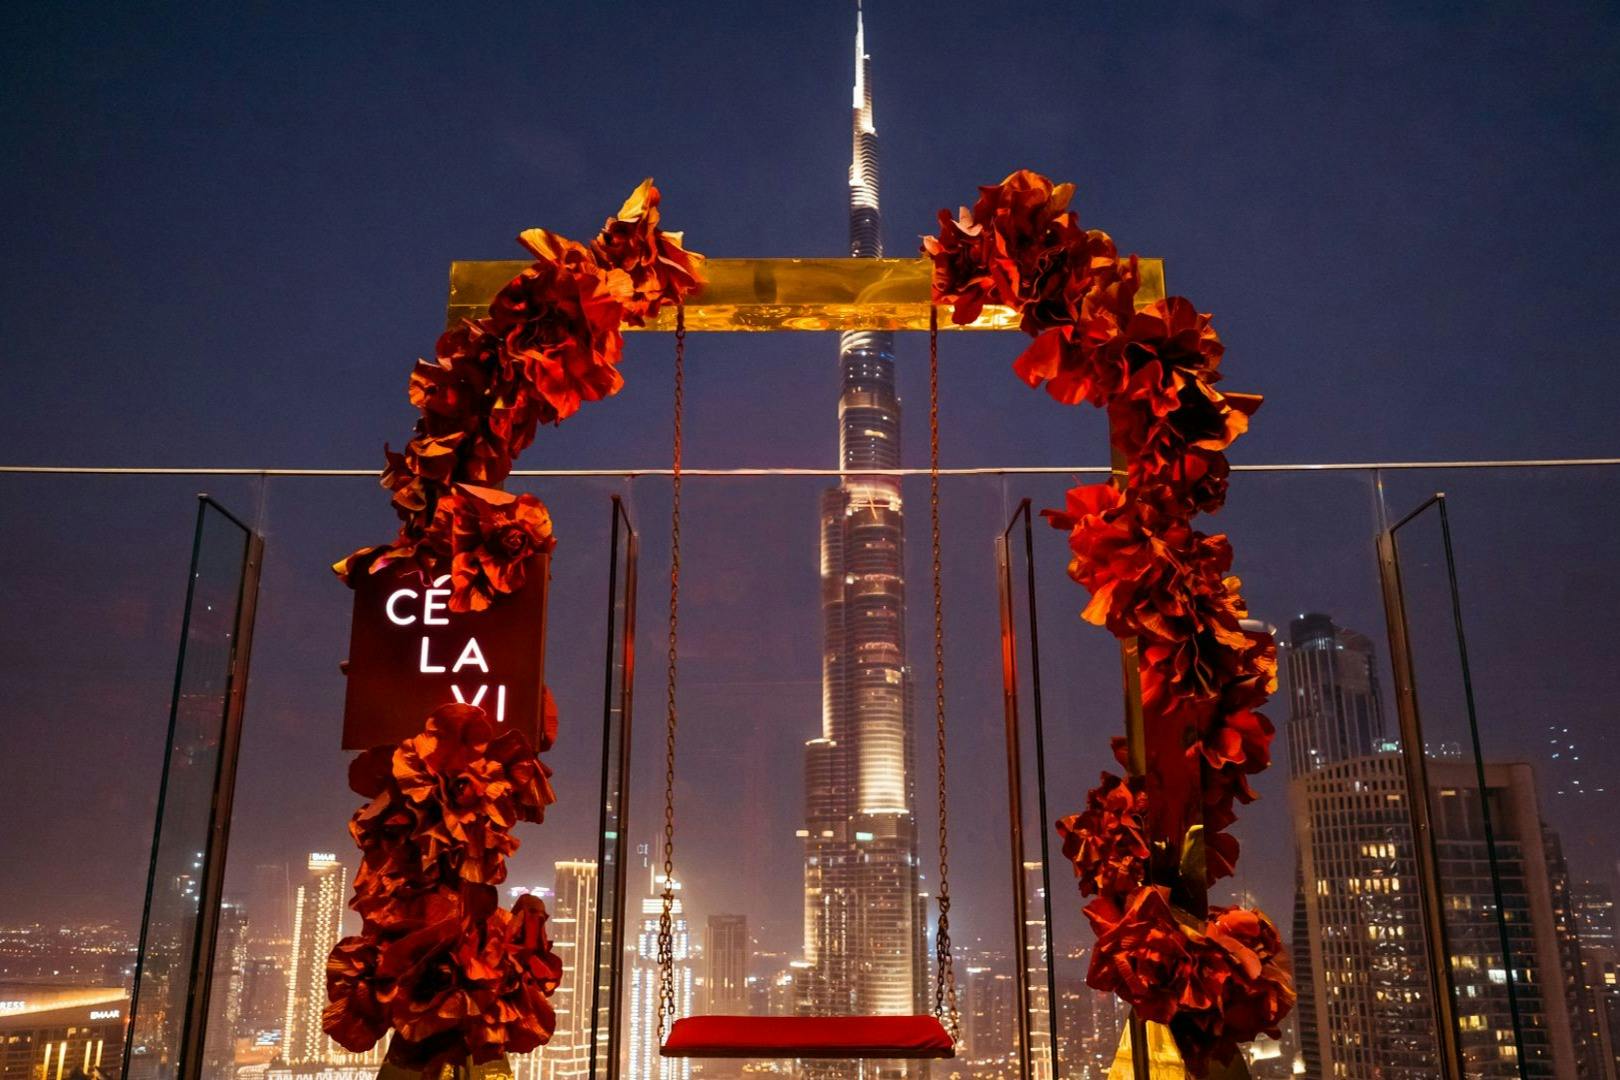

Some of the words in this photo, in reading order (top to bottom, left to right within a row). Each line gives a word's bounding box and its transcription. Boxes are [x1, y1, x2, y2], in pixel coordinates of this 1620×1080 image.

[385, 574, 452, 625] CÉ
[420, 637, 489, 673] LA
[90, 1010, 120, 1019] EMAAR
